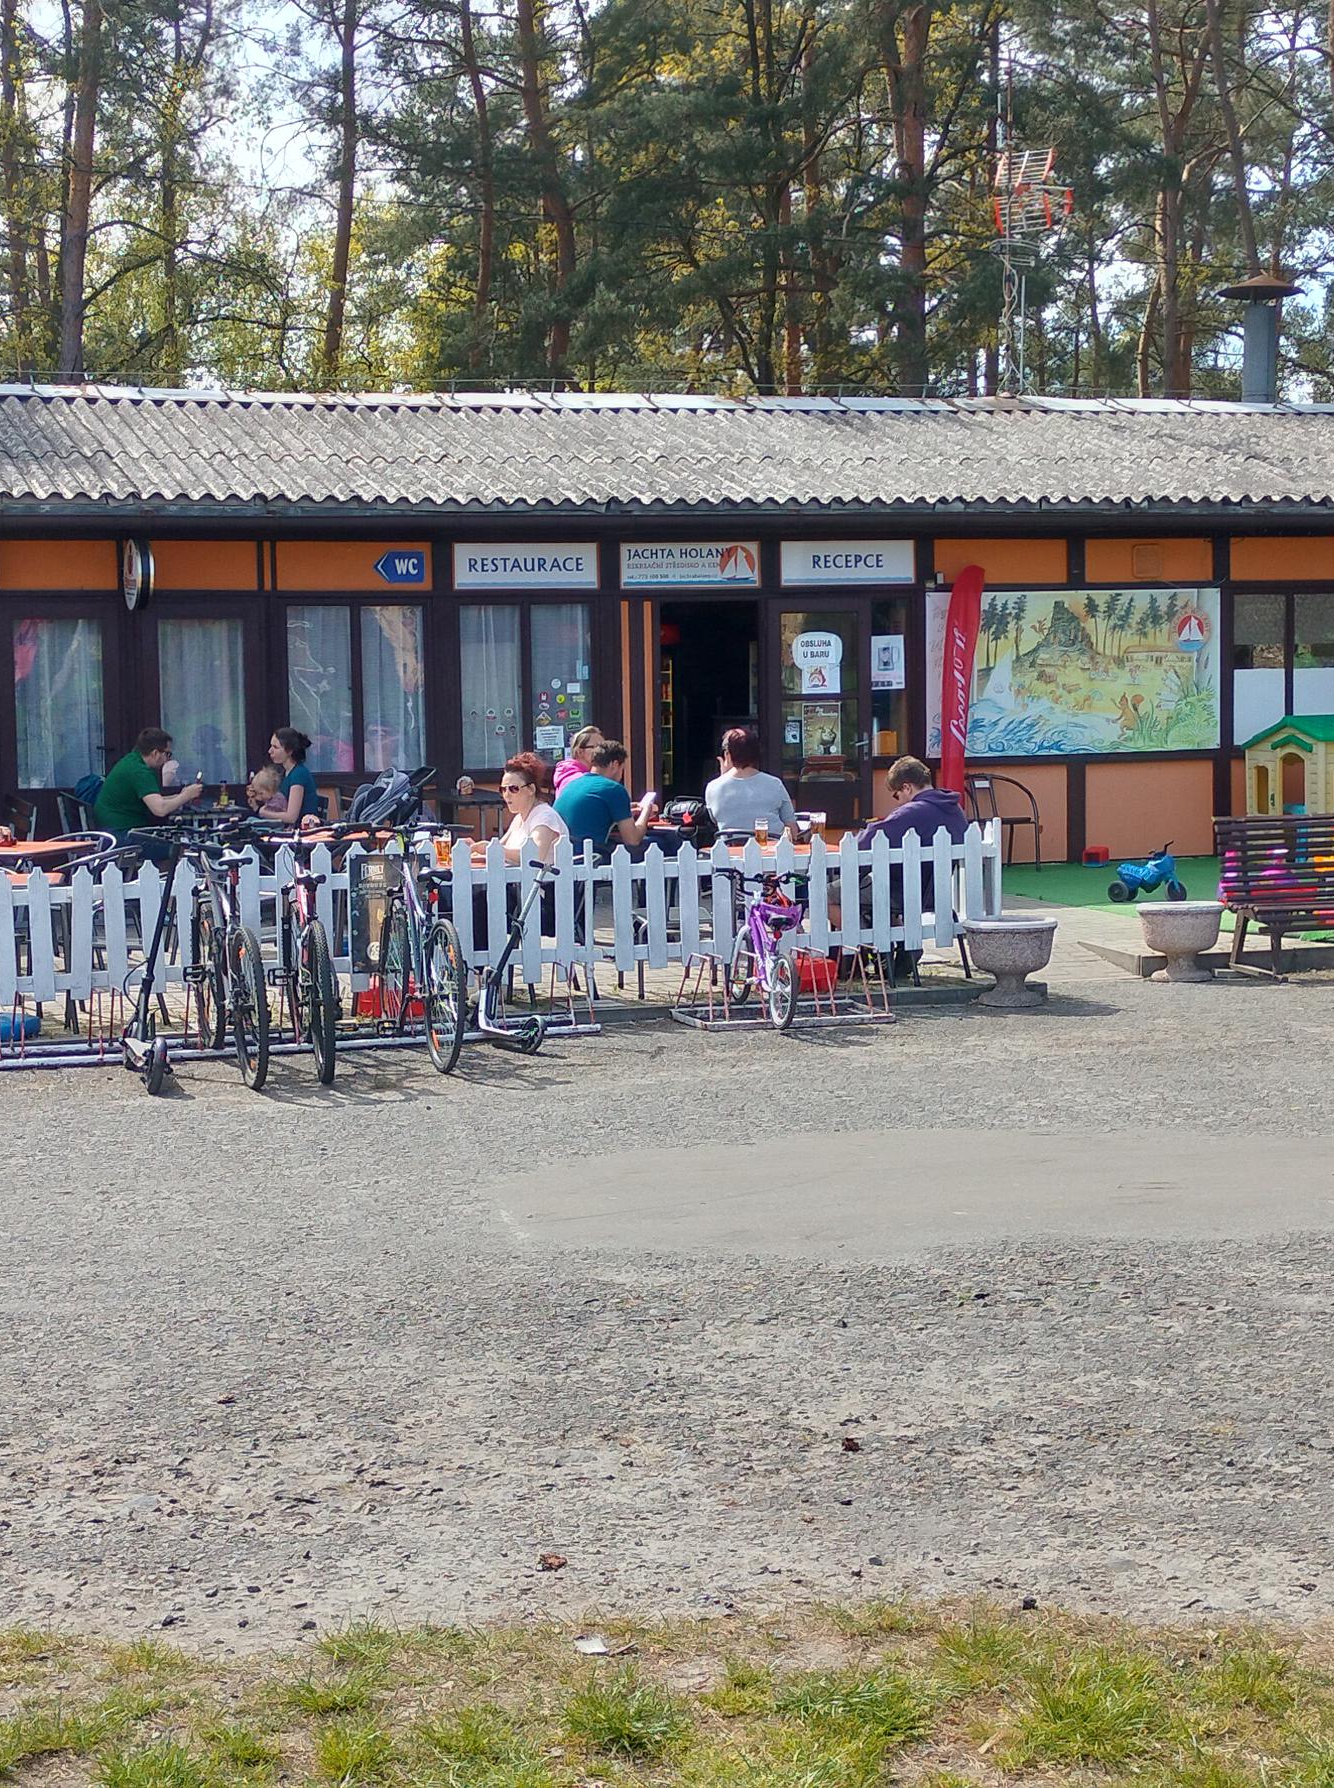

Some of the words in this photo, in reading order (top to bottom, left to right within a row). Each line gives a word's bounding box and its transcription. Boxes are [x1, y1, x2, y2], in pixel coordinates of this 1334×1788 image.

[626, 547, 675, 560] JACHTA
[679, 546, 732, 559] HOLANY
[394, 557, 419, 575] WC
[467, 556, 585, 573] RESTAURACE
[811, 553, 884, 569] RECEPCE
[800, 639, 832, 648] OBSLUHA
[810, 650, 830, 658] BARU
